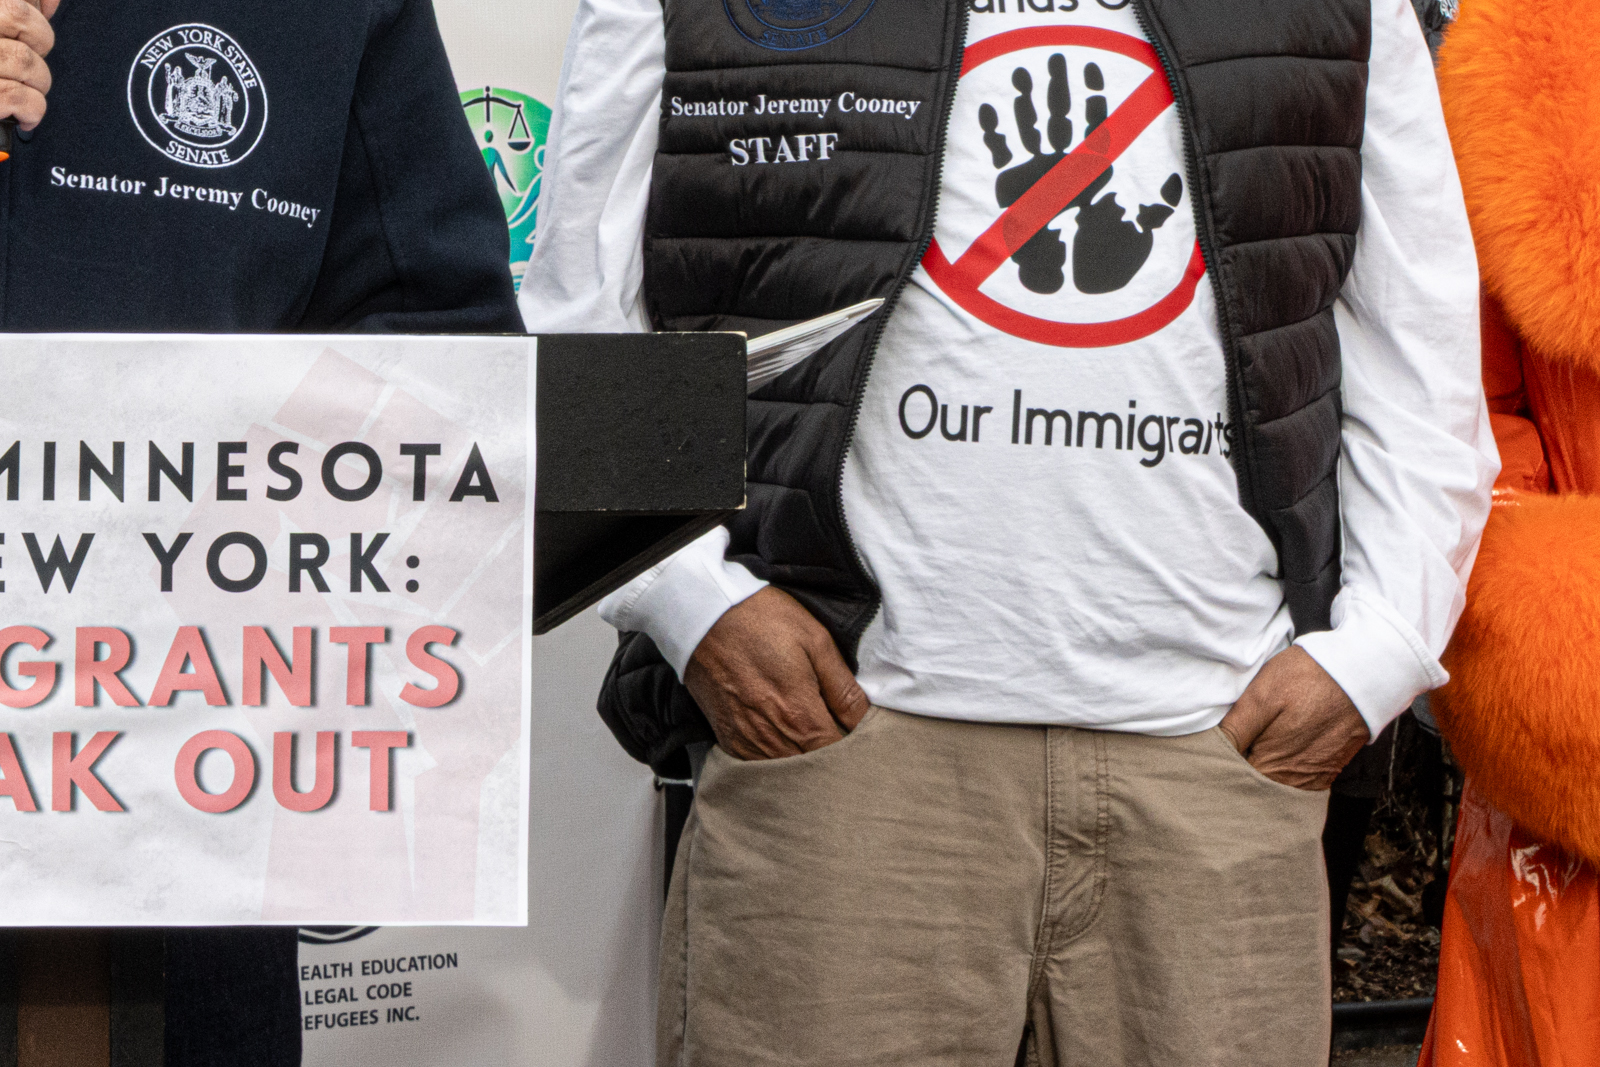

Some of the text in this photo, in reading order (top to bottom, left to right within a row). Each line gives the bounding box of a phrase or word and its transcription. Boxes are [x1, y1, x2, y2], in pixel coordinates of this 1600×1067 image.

[759, 28, 828, 46] SENATE
[140, 29, 258, 89] NEW YORK STATE
[672, 92, 920, 119] Senator Jeremy Cooney
[165, 140, 231, 165] SENATE
[730, 133, 838, 165] STAFF
[51, 167, 321, 228] Senator Jeremy Cooney
[898, 384, 993, 442] Our
[142, 532, 420, 594] YORK:
[174, 729, 415, 813] OUT
[301, 953, 457, 980] EALTH EDUCATION
[305, 982, 412, 1005] LEGAL CODE
[304, 1006, 419, 1030] EFUGEES INC.
